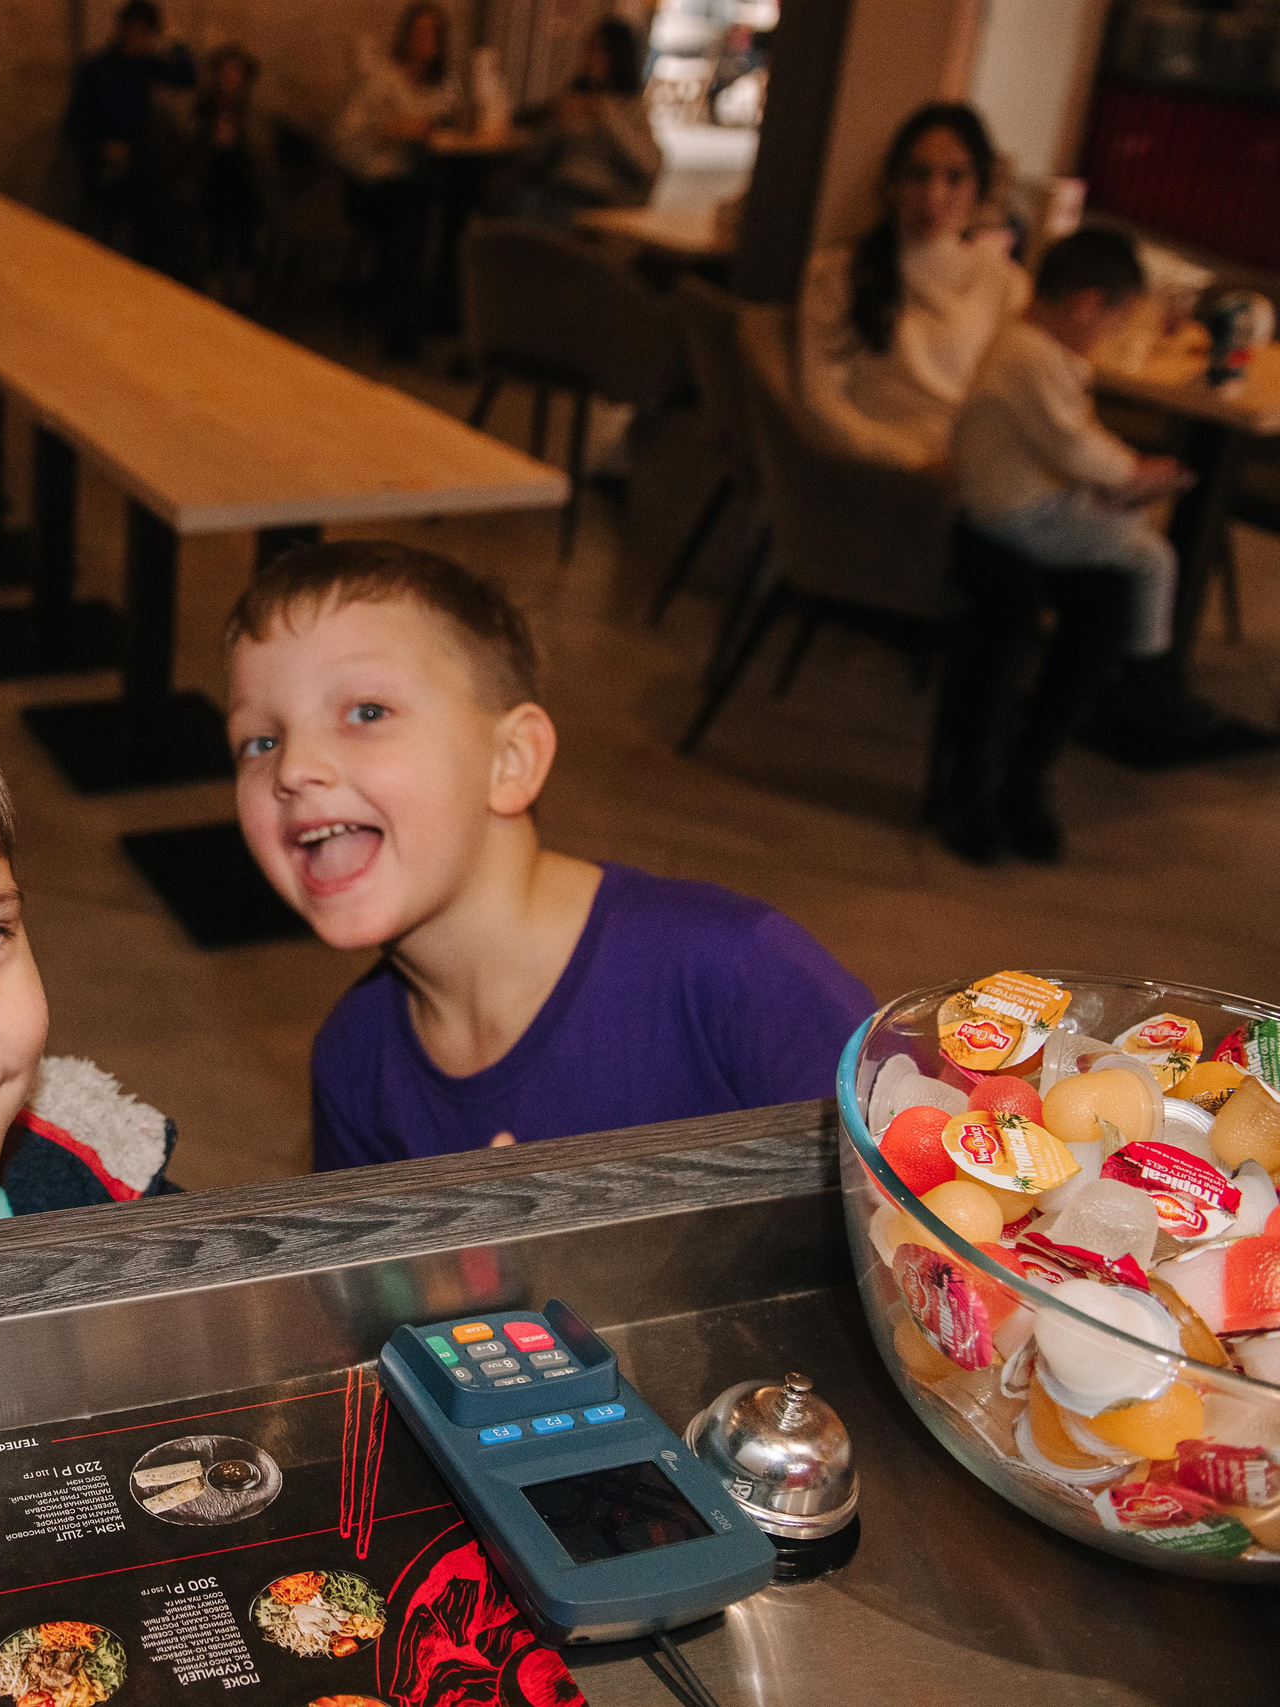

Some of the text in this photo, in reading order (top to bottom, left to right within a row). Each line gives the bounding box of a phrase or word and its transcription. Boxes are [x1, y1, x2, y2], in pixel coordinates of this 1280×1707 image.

[984, 986, 1003, 996] GELS
[1002, 992, 1028, 1006] FRUITY
[972, 993, 1039, 1026] Tropical
[962, 1025, 1007, 1048] New Choice
[970, 1127, 990, 1161] New Choice
[1003, 1127, 1037, 1177] Tropical
[1146, 1159, 1224, 1195] MINI FRUITY GELS
[1172, 1164, 1225, 1189] Lychee Flavor
[1141, 1166, 1220, 1209] Tropical
[1150, 1198, 1173, 1213] Cho
[1175, 1206, 1196, 1223] New
[464, 1325, 489, 1333] CLEAR
[520, 1334, 548, 1343] CANCEL
[554, 1351, 562, 1359] 7
[504, 1359, 513, 1367] 8
[598, 1407, 613, 1415] F1
[545, 1417, 562, 1425] F2
[493, 1428, 509, 1436] F3
[61, 1466, 72, 1476] Р
[75, 1461, 102, 1473] 220
[25, 1495, 114, 1514] СТЕКЛЯННАЯ РИСОВАЯ
[89, 1509, 119, 1517] БУМАГИ
[711, 1509, 732, 1531] S200
[82, 1515, 122, 1527] ЖАРЕНЫЙ
[6, 1529, 46, 1540] РИСОВОЙ
[55, 1522, 125, 1541] НЭМ 2ШТ
[173, 1583, 184, 1594] Р
[188, 1577, 218, 1591] 300
[157, 1643, 188, 1653] ТОМАТЫ
[208, 1639, 244, 1650] МОРКОВЬ
[173, 1657, 231, 1672] МЯСО КУРИНОЕ
[178, 1660, 254, 1685] С КУРИЦЕЙ
[222, 1673, 260, 1689] ПОКЕ
